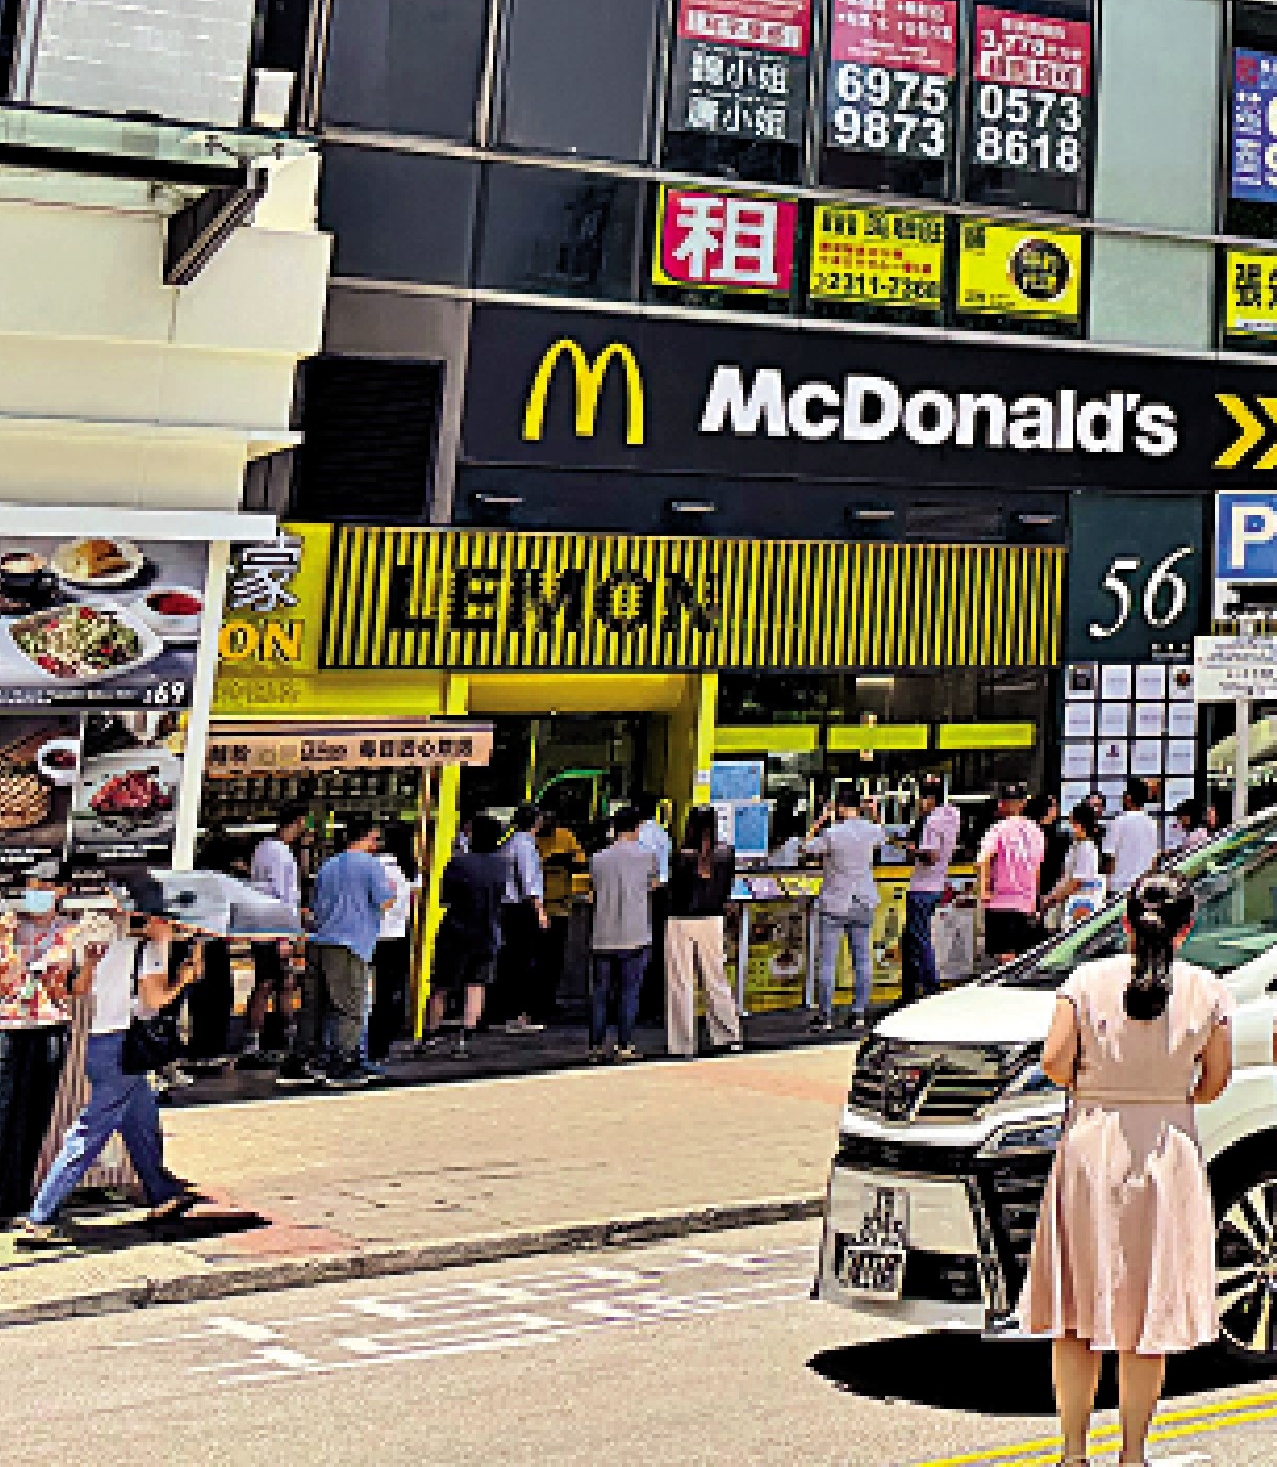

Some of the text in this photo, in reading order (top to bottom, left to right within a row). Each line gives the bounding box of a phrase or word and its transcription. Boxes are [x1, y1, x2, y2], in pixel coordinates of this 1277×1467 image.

[836, 64, 948, 113] 6975
[979, 84, 1082, 133] 0573
[833, 106, 946, 157] 9873
[976, 126, 1081, 174] 8618
[673, 196, 780, 286] 租
[700, 364, 1179, 456] McDonald's
[392, 569, 720, 634] LEMON
[1089, 545, 1195, 639] 56
